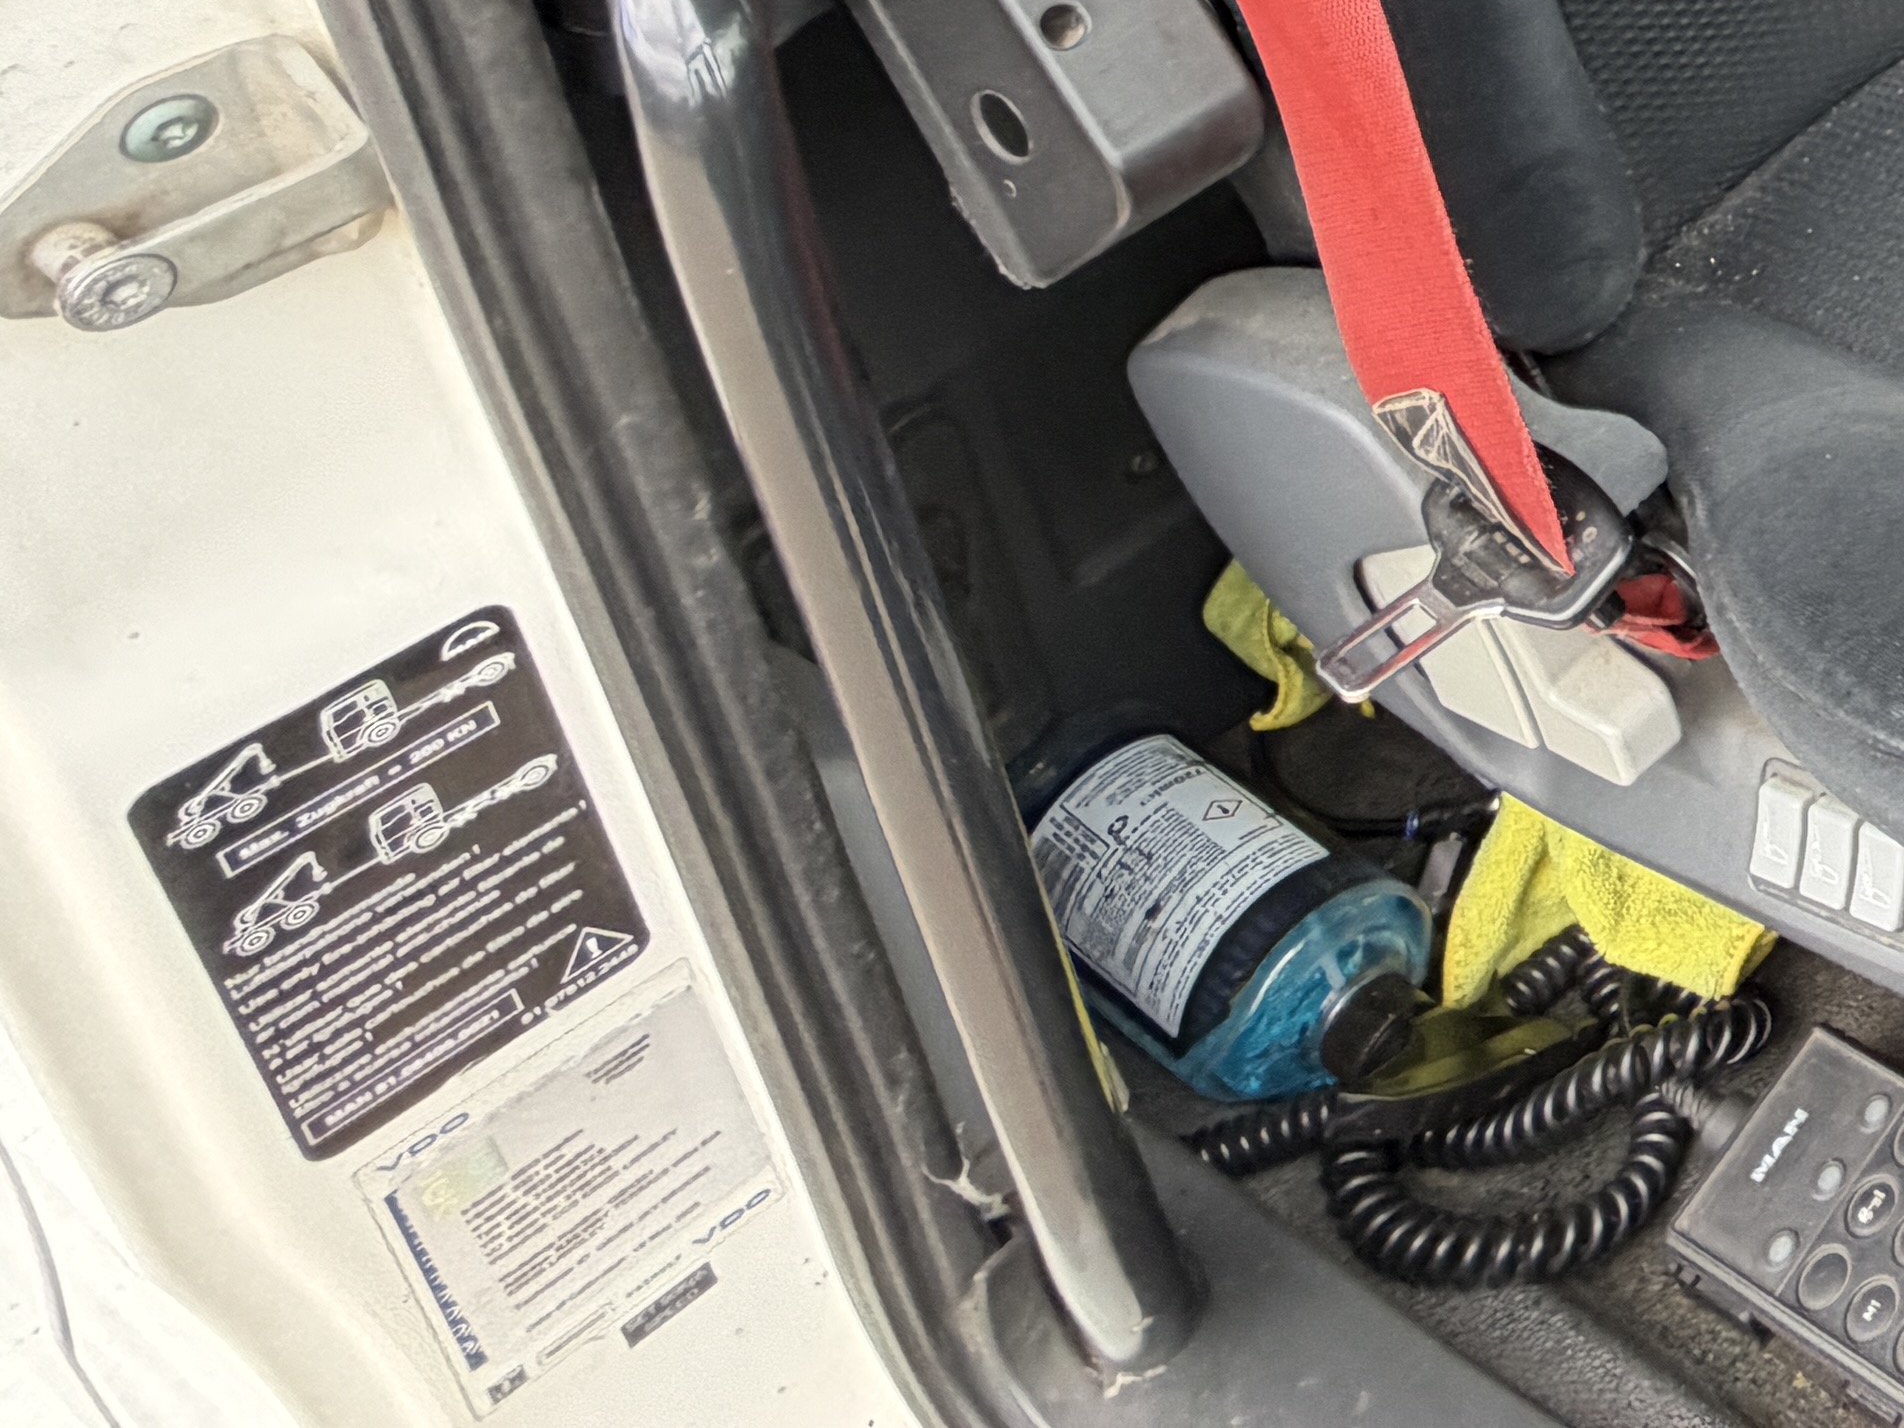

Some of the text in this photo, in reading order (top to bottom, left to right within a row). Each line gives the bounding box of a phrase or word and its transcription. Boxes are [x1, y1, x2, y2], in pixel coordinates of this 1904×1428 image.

[375, 1109, 471, 1171] VDO
[1750, 1108, 1809, 1183] MAN
[690, 1185, 772, 1244] VDO
